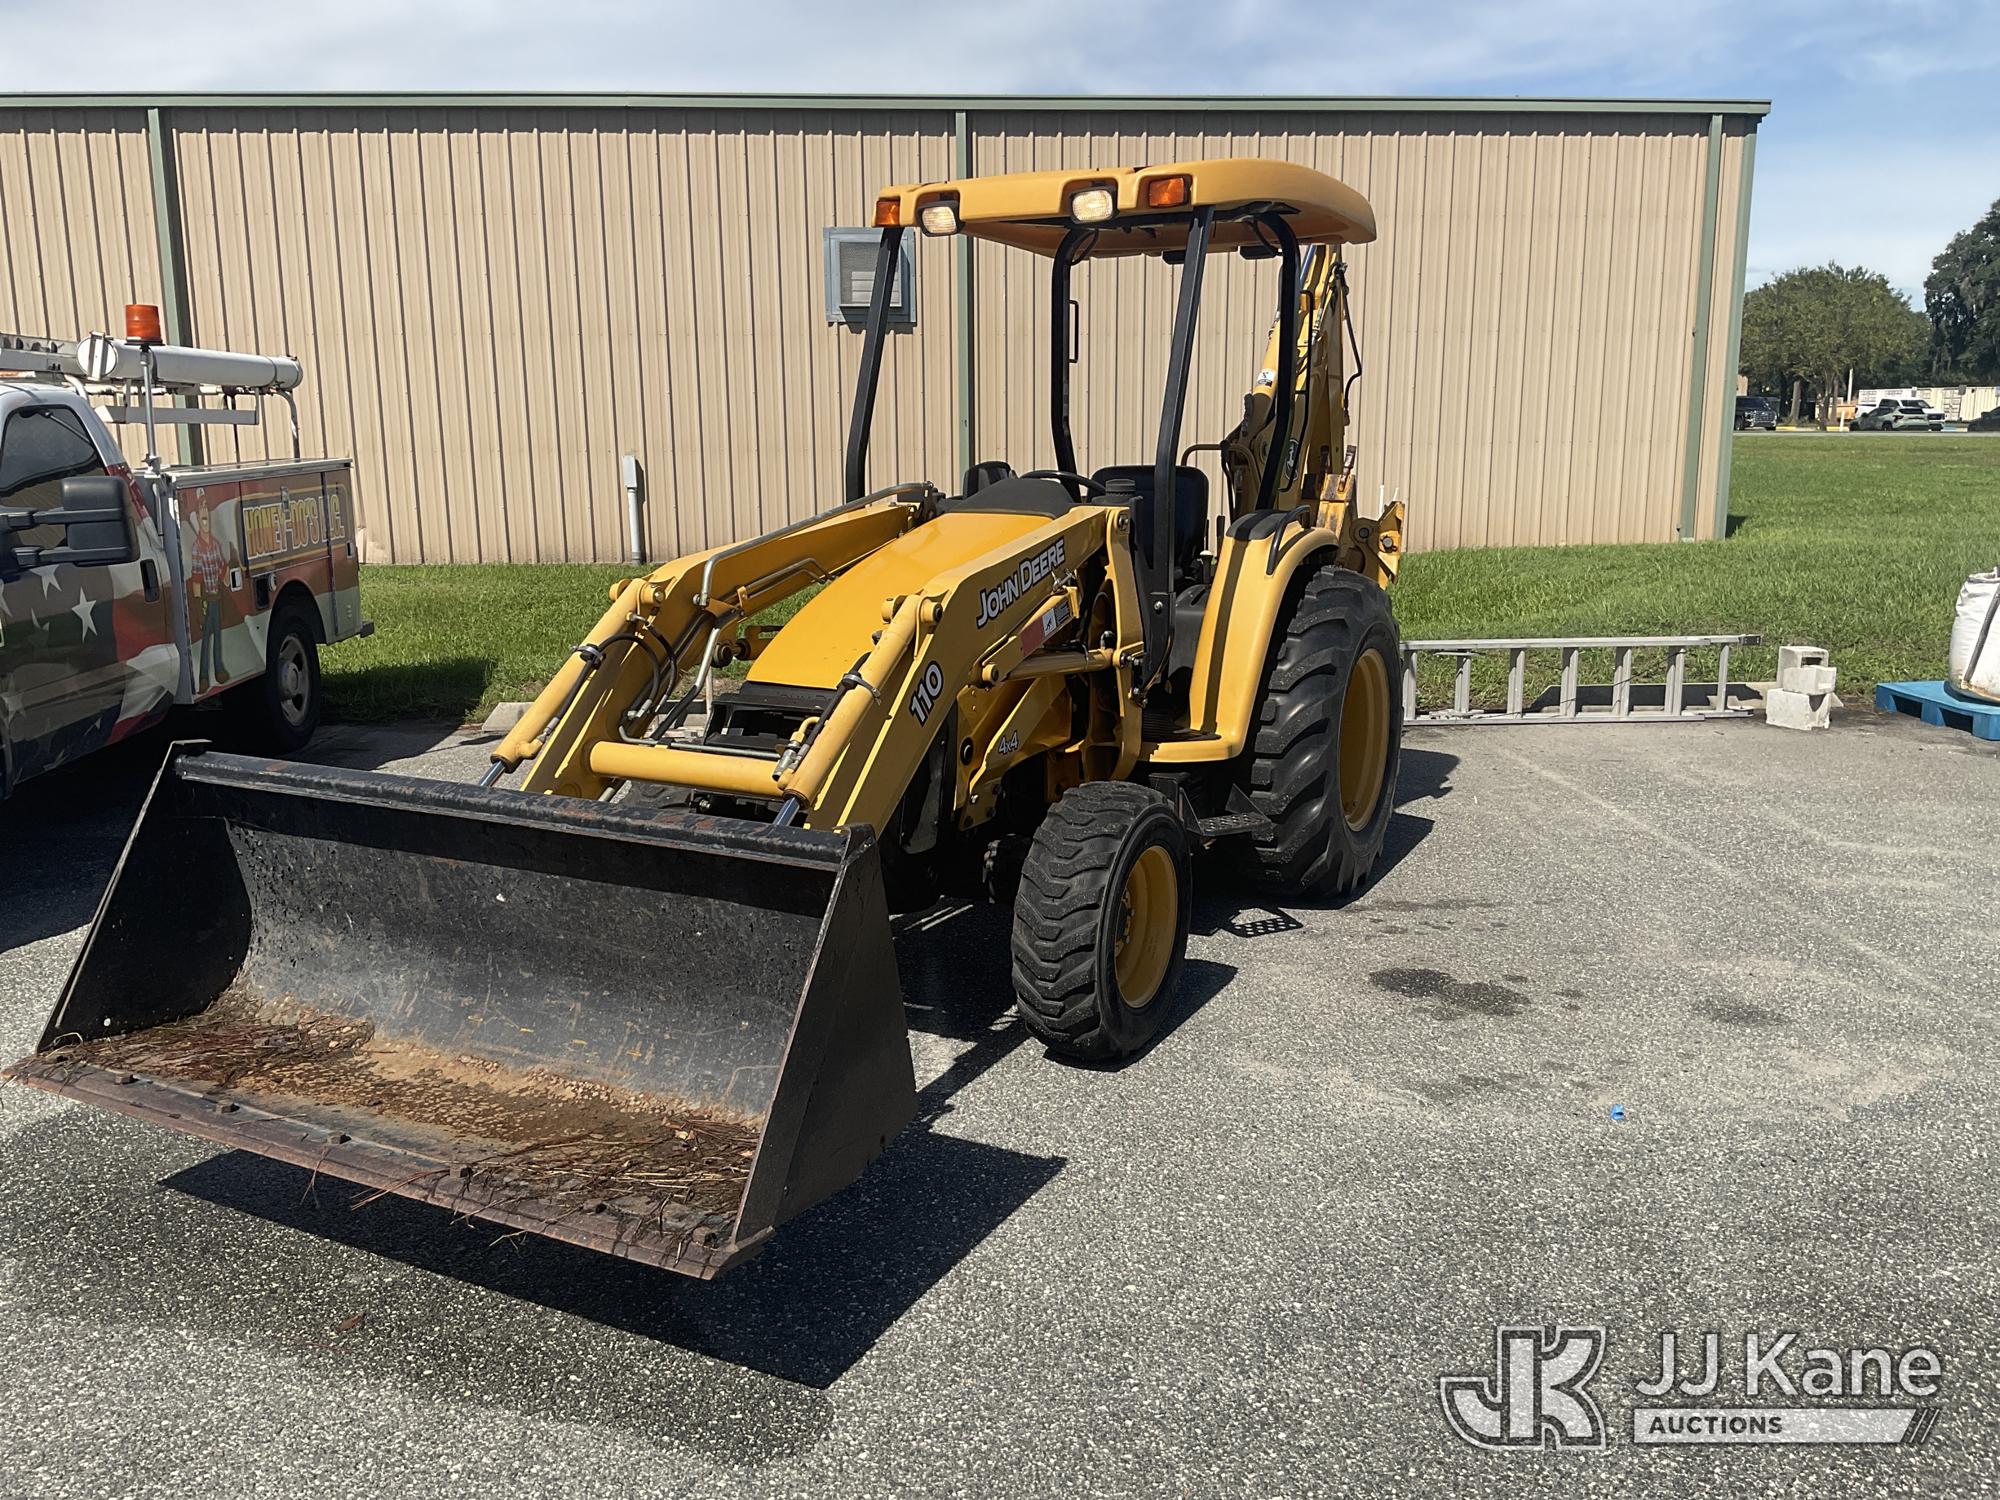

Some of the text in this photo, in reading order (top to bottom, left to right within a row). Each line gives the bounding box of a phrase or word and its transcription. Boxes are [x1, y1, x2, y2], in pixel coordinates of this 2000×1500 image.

[976, 536, 1066, 630] JOHN DEERE
[909, 660, 944, 728] 110
[998, 730, 1019, 755] 4x4
